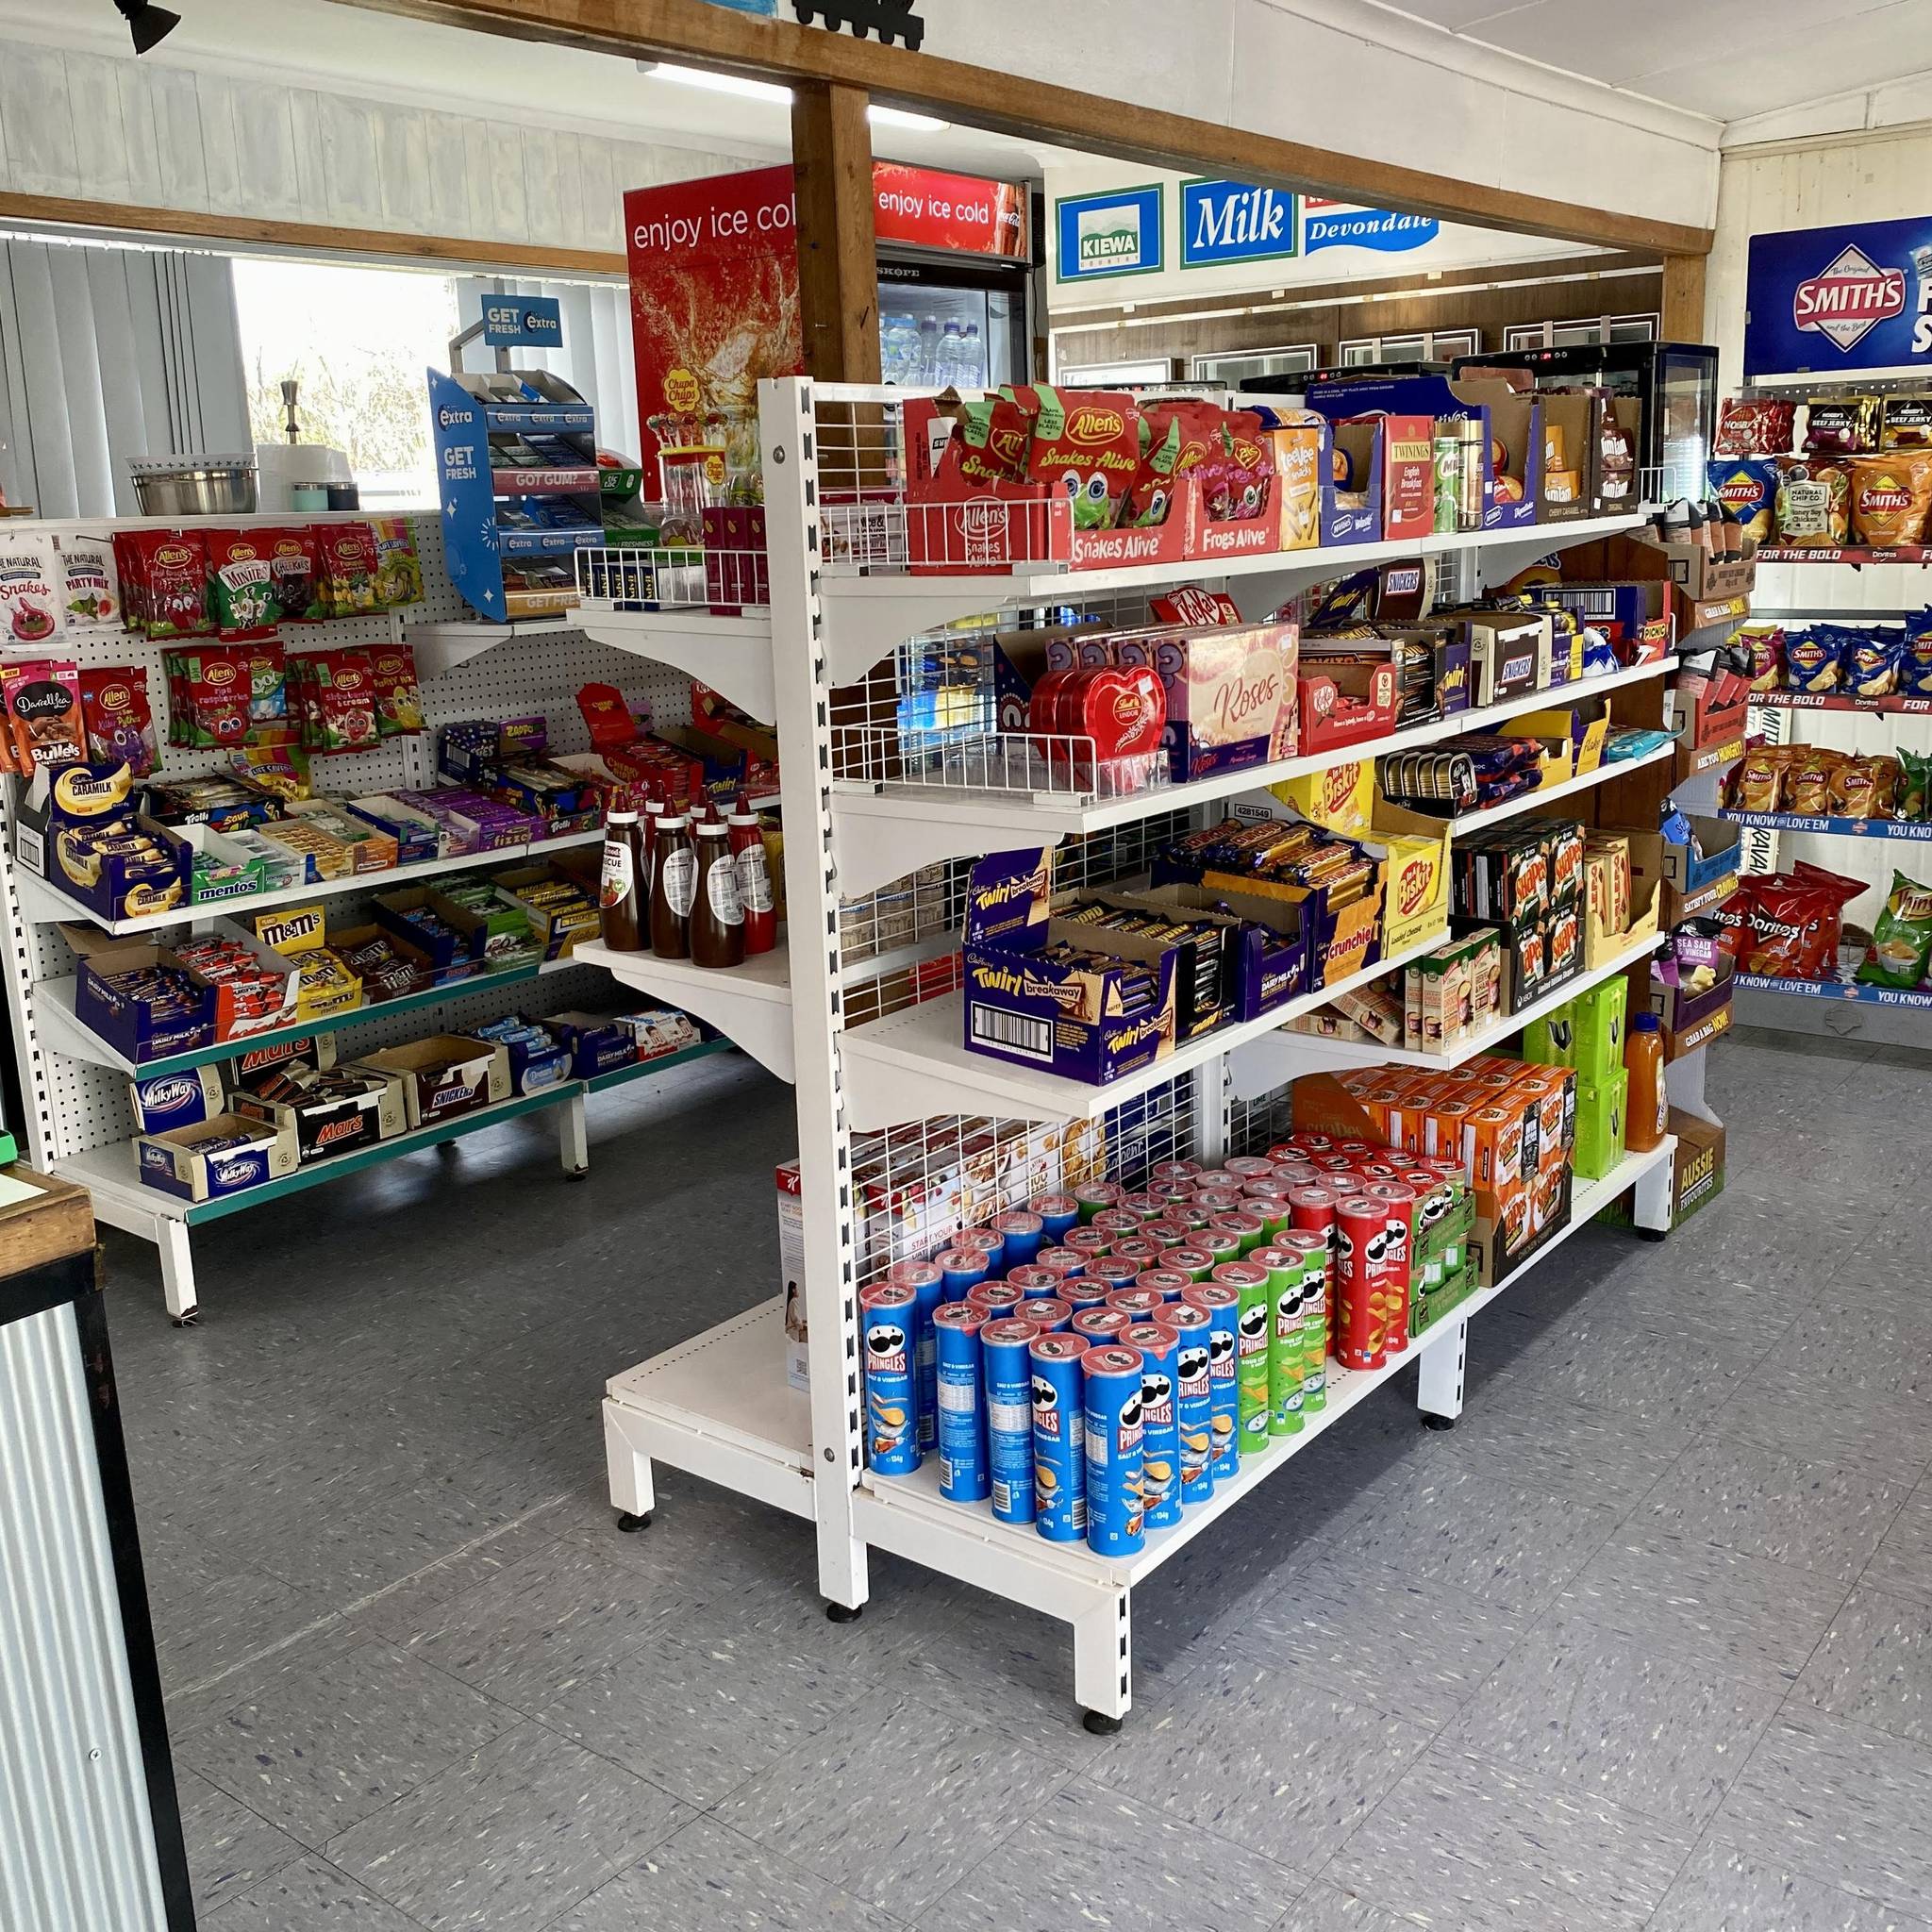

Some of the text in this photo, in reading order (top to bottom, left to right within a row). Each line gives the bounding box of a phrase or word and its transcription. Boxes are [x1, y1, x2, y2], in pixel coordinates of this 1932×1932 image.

[878, 189, 923, 219] enjoy
[928, 194, 951, 219] ice
[955, 197, 990, 225] cold
[1192, 187, 1284, 248] Milk
[1309, 211, 1432, 241] Devondale
[634, 214, 701, 252] enjoy
[710, 206, 748, 238] ice
[1082, 235, 1136, 257] KIEWA
[876, 266, 920, 277] SKOPE
[1797, 278, 1902, 315] SMITH'S
[488, 307, 521, 335] GET FRESH
[526, 311, 557, 330] extra
[668, 378, 694, 390] Chupa
[668, 387, 696, 404] Chups
[440, 408, 473, 426] extra
[496, 411, 521, 423] extra
[1070, 414, 1124, 439] Allen's
[443, 447, 474, 466] GET
[1039, 448, 1138, 471] Snakes Alive
[1393, 444, 1429, 458] TWININGS
[445, 467, 476, 481] FRESH
[515, 474, 577, 487] GOT GUM?
[1404, 466, 1420, 478] English
[1400, 478, 1422, 490] Breakfast
[1719, 486, 1760, 499] SMITH'S
[1860, 490, 1911, 508] SMITH'S
[275, 541, 302, 555] Allen's
[337, 541, 361, 557] Allen's
[508, 534, 597, 549] extra extra extra
[1074, 535, 1158, 560] Snakes Alive
[1203, 528, 1266, 552] Frogs Alive
[61, 554, 105, 567] THE NATURAL
[158, 548, 190, 565] Allen's
[229, 545, 255, 559] Allen's
[1757, 550, 1842, 560] FOR THE BOLD
[7, 557, 41, 568] NATURAL
[66, 577, 109, 591] PARTY MIX
[226, 566, 269, 588] MINTIES
[1389, 570, 1418, 593] SNICKERS
[1, 580, 51, 600] Snakes
[1178, 588, 1218, 626] KitKat
[1643, 623, 1667, 641] PICNIC
[1793, 649, 1824, 658] SMITH'S
[207, 666, 234, 681] Allen's
[1443, 664, 1466, 691] Twirl
[1502, 655, 1533, 683] SNICKERS
[336, 671, 361, 686] Allen's
[17, 691, 71, 711] Darrell Lea
[344, 698, 370, 708] cream
[1211, 672, 1279, 731] Roses
[1313, 684, 1336, 711] KitKat
[1769, 694, 1825, 705] THE BOLD
[1903, 700, 1930, 710] FOR
[506, 724, 534, 737] ZAPPO
[31, 742, 79, 761] Bullets
[1583, 736, 1602, 757] Flake
[72, 781, 112, 796] CARAMILK
[709, 777, 737, 793] Twirl
[185, 812, 209, 824] Trolli
[223, 810, 250, 824] SOUR
[1237, 806, 1270, 818] 4281549
[1726, 812, 1829, 830] YOU KNOW LOVE'EM
[1888, 824, 1907, 837] YOU
[199, 880, 258, 901] mentos
[975, 874, 1046, 911] Twirl breakaway
[1398, 861, 1433, 914] Biskit
[137, 893, 167, 907] CARAMILK
[261, 911, 321, 946] m&m's
[1747, 913, 1801, 940] Doritos
[1328, 926, 1373, 959] crunchie
[1677, 939, 1712, 951] SEA SALT
[1685, 948, 1712, 959] VINEGAR
[973, 967, 1081, 1000] Twirl breakaway
[1262, 976, 1279, 992] DAIRY
[1740, 975, 1822, 994] KNOW LOVE'EM
[1878, 991, 1932, 1007] YOU KNOW
[1108, 1025, 1140, 1055] Twirl
[1140, 1013, 1172, 1038] breakaway
[597, 1052, 617, 1064] DAIRY
[144, 1082, 191, 1108] MilkyWay
[433, 1087, 474, 1108] SNICKERS
[318, 1116, 364, 1144] Mars
[220, 1163, 255, 1183] MilkyWay
[1681, 1148, 1714, 1190] AUSSIE
[1680, 1175, 1714, 1210] FAVOURITES
[867, 1353, 907, 1374] PRINGLES
[882, 1374, 908, 1383] VINEGAR
[1147, 1425, 1174, 1436] VINEGAR
[890, 1455, 904, 1464] 134g
[1117, 1452, 1132, 1461] SALT
[1155, 1511, 1169, 1522] 134g
